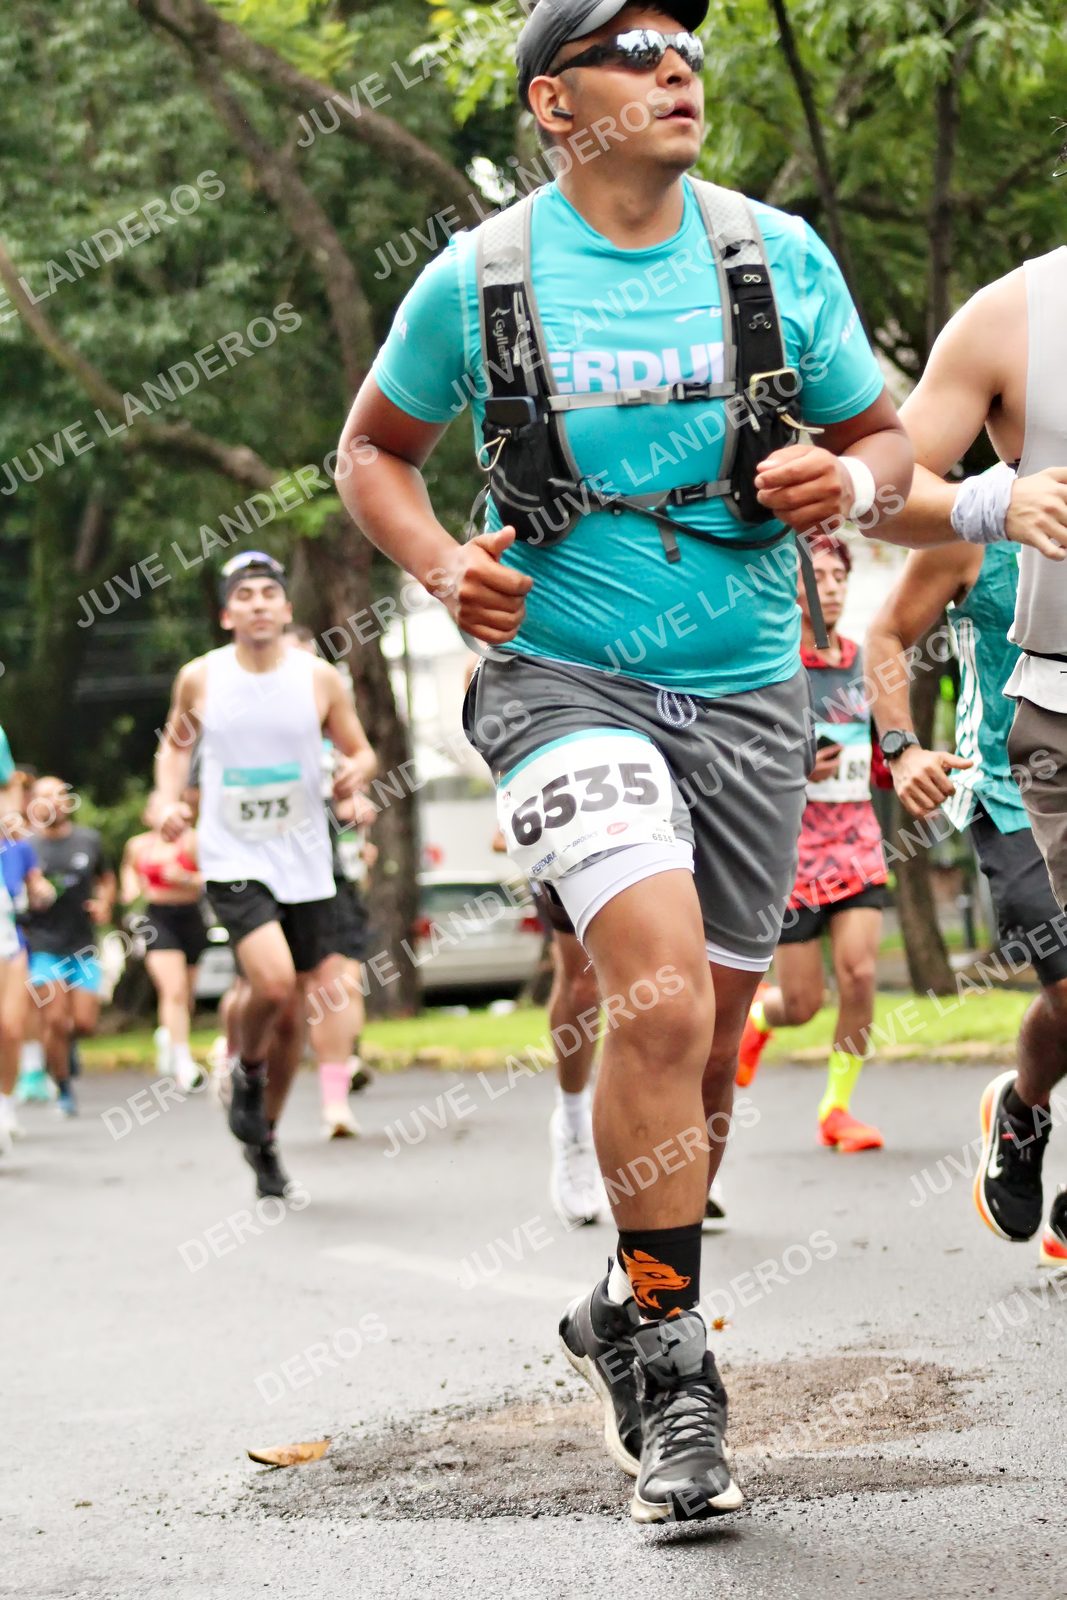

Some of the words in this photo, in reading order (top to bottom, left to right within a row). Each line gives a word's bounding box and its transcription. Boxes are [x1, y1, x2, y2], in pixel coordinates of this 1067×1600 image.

[240, 797, 290, 821] 573
[511, 763, 659, 846] 6535
[652, 833, 673, 843] 6535
